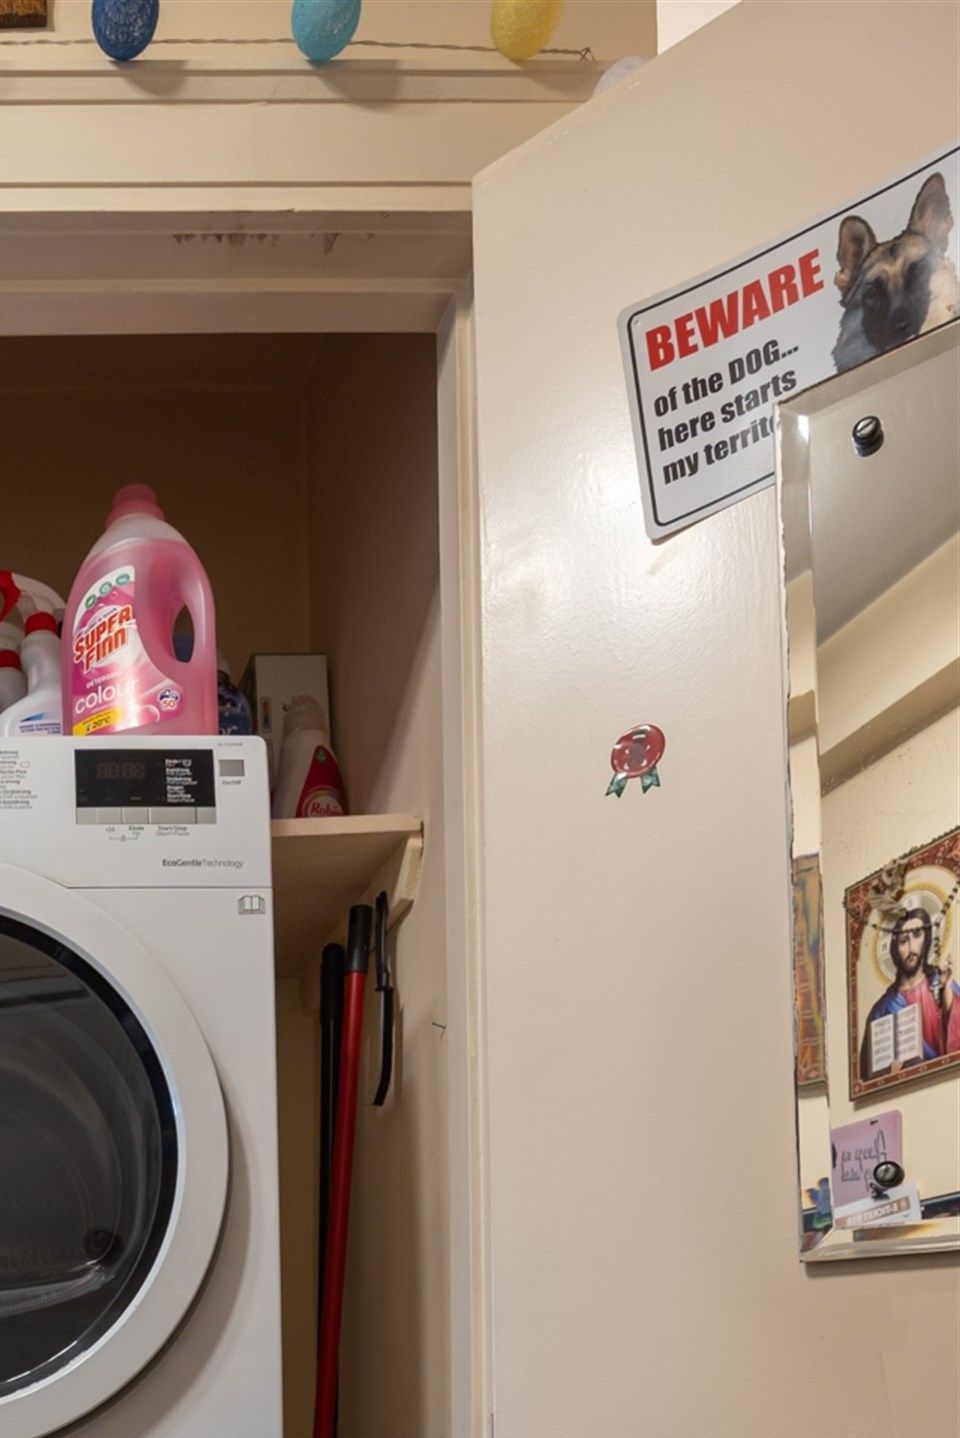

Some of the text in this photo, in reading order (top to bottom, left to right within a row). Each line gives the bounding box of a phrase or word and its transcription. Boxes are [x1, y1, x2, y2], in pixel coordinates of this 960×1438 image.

[645, 248, 825, 372] BEWARE
[654, 339, 800, 418] of the DOG...
[659, 369, 797, 452] here starts
[663, 452, 699, 485] my
